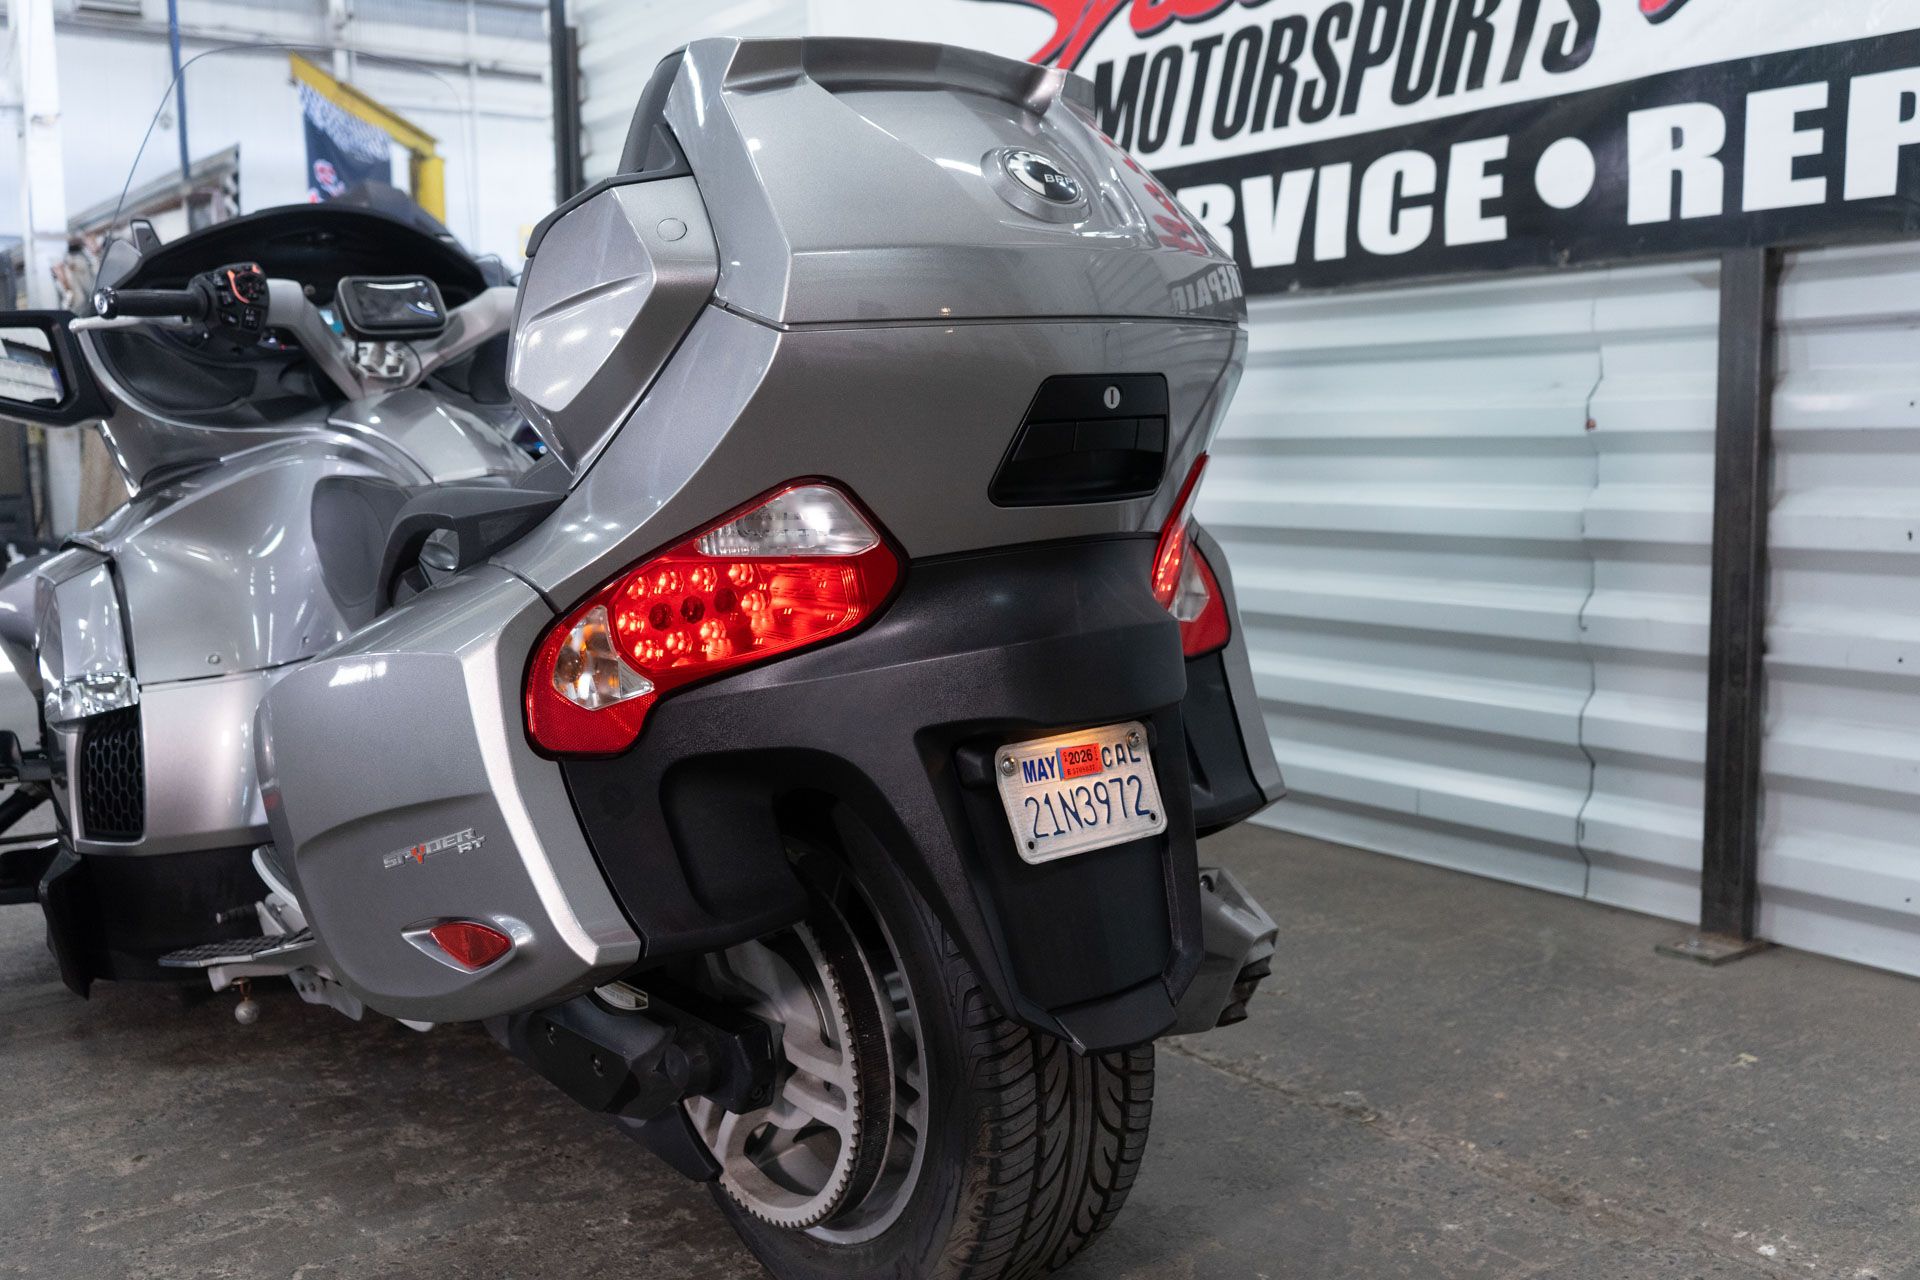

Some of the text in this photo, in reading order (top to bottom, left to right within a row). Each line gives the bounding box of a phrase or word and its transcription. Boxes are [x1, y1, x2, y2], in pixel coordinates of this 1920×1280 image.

[1094, 0, 1601, 154] MOTORSPORTS
[1044, 173, 1073, 184] BRP
[1177, 66, 1920, 268] RVICE REP
[1022, 755, 1056, 784] MAY
[1068, 748, 1093, 765] 2026
[1101, 743, 1141, 768] CAL
[1024, 774, 1150, 839] 21N3972
[383, 828, 475, 869] SPYDER
